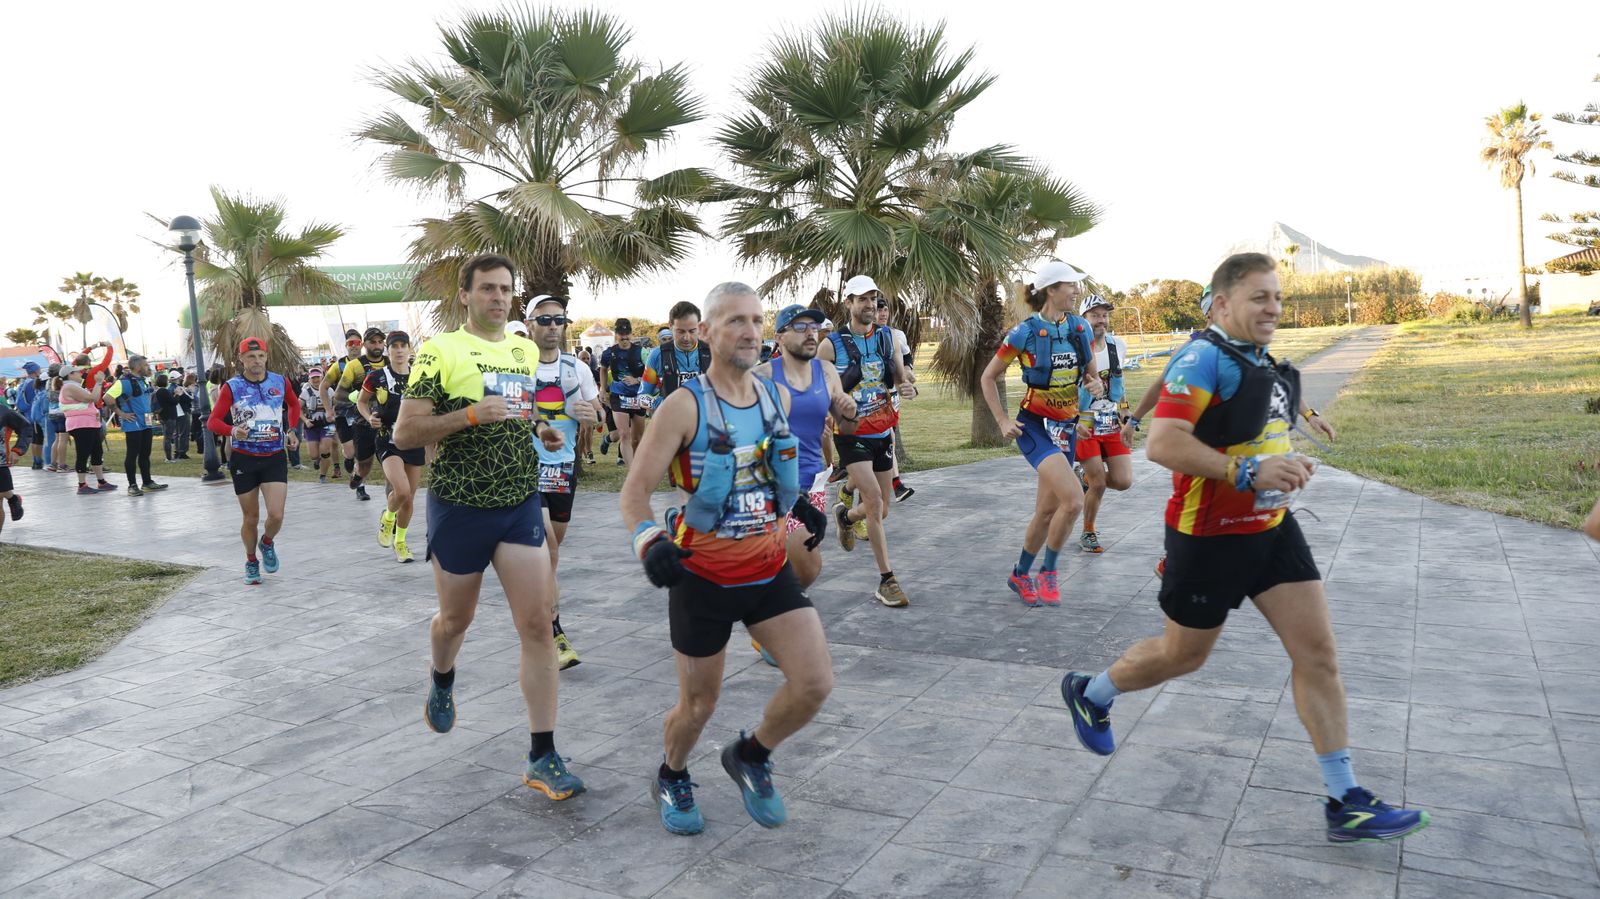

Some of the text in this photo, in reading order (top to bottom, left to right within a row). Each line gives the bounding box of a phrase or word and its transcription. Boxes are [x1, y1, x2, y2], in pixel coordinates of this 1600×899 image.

[501, 381, 522, 398] 146
[866, 391, 878, 403] 24
[257, 423, 271, 432] 122
[540, 466, 561, 478] 204
[737, 491, 766, 512] 193
